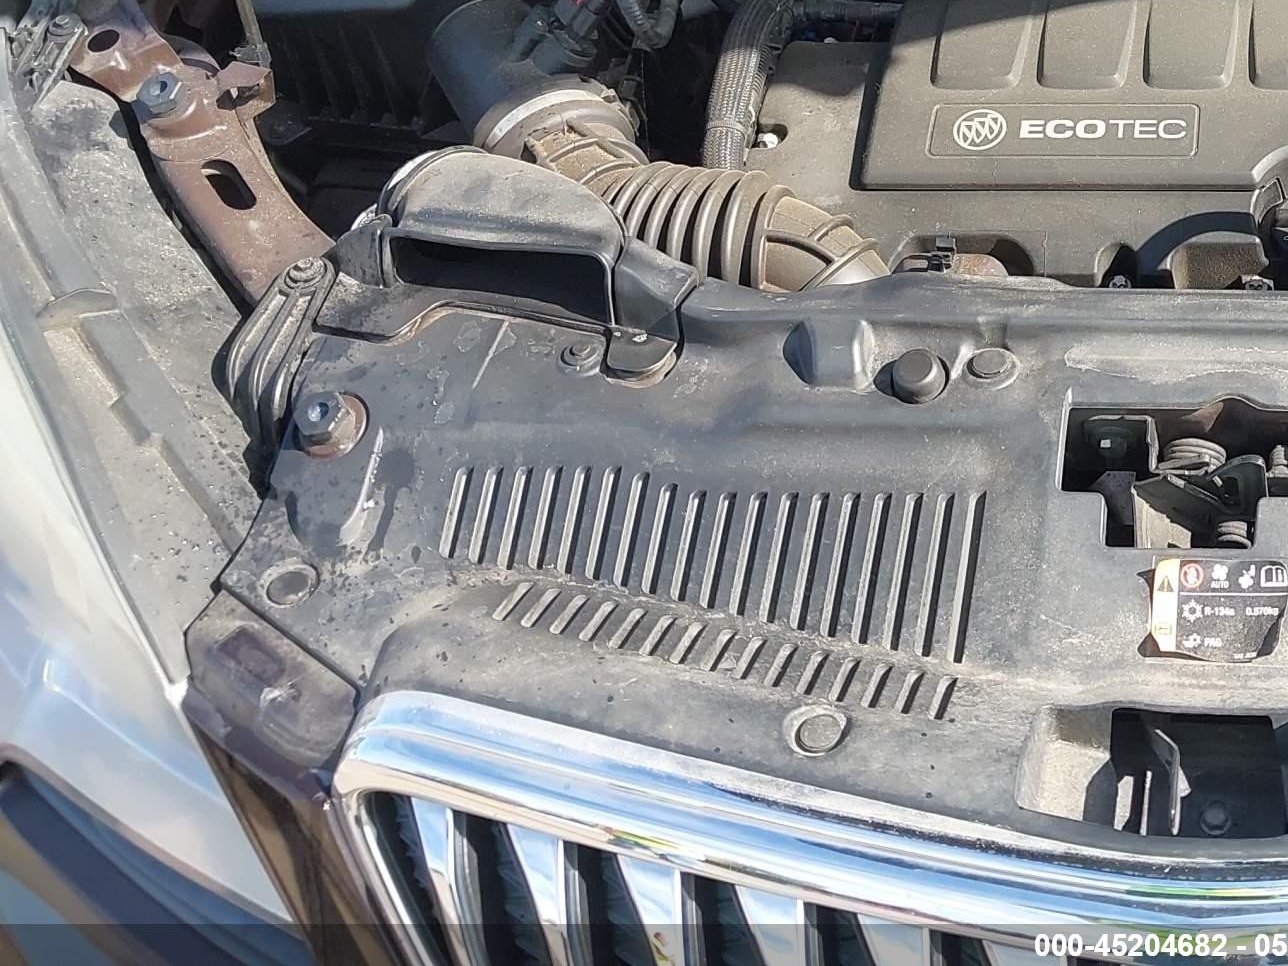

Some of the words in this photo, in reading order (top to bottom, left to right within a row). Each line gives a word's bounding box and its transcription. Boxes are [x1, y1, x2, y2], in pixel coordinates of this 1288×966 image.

[1019, 119, 1187, 139] ECOTEC
[1210, 581, 1229, 589] AUTO
[1203, 607, 1236, 616] R-134a
[1246, 607, 1279, 616] 0.570kg
[1203, 637, 1222, 647] PAG
